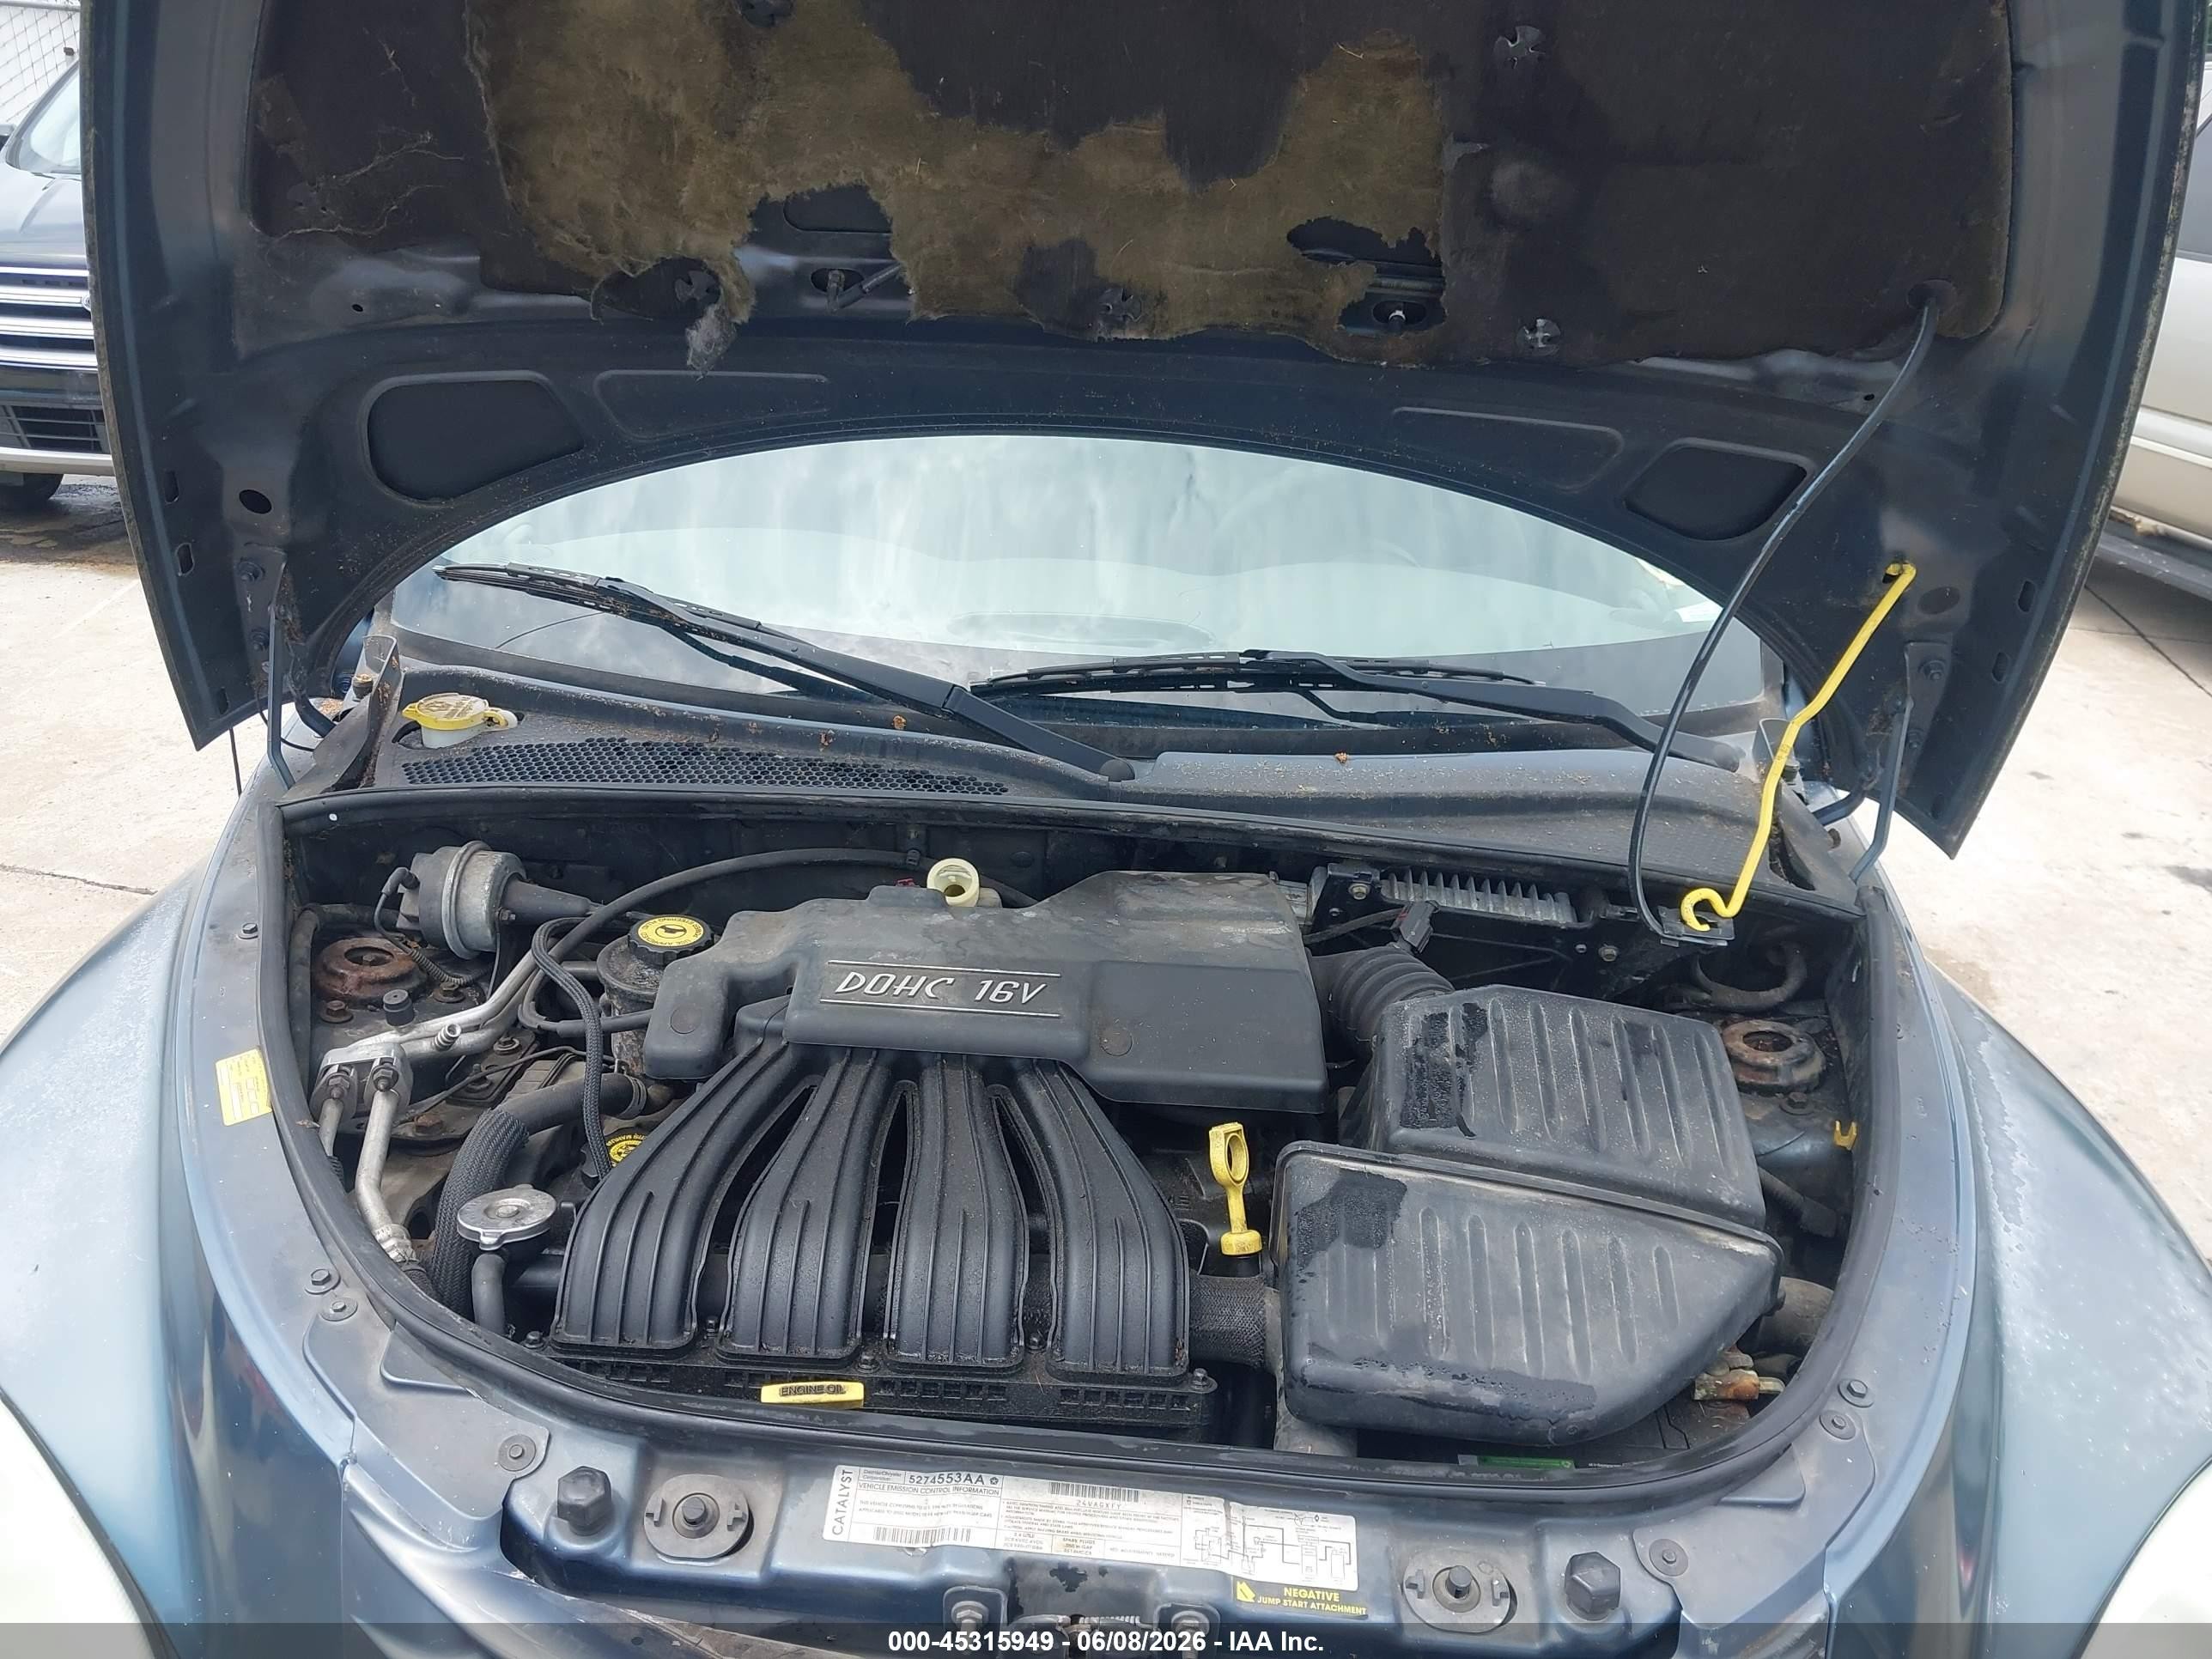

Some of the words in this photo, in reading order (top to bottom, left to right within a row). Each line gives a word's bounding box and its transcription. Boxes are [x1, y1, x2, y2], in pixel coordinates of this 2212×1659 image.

[835, 971, 956, 999] DOHC
[975, 979, 1047, 1004] 16V
[780, 1385, 824, 1397] ENGINE
[826, 1384, 847, 1395] OIL
[908, 1473, 985, 1485] 5274553AA
[859, 1482, 885, 1491] VEHICLE
[887, 1484, 919, 1493] EMISSION
[952, 1486, 1000, 1496] INFORMATION
[832, 1469, 853, 1535] CATALYST
[1284, 1587, 1340, 1602] NEGATIVE
[1257, 1596, 1280, 1606] JUMP
[1283, 1599, 1308, 1608] START
[1310, 1602, 1367, 1615] ATTACHMENT
